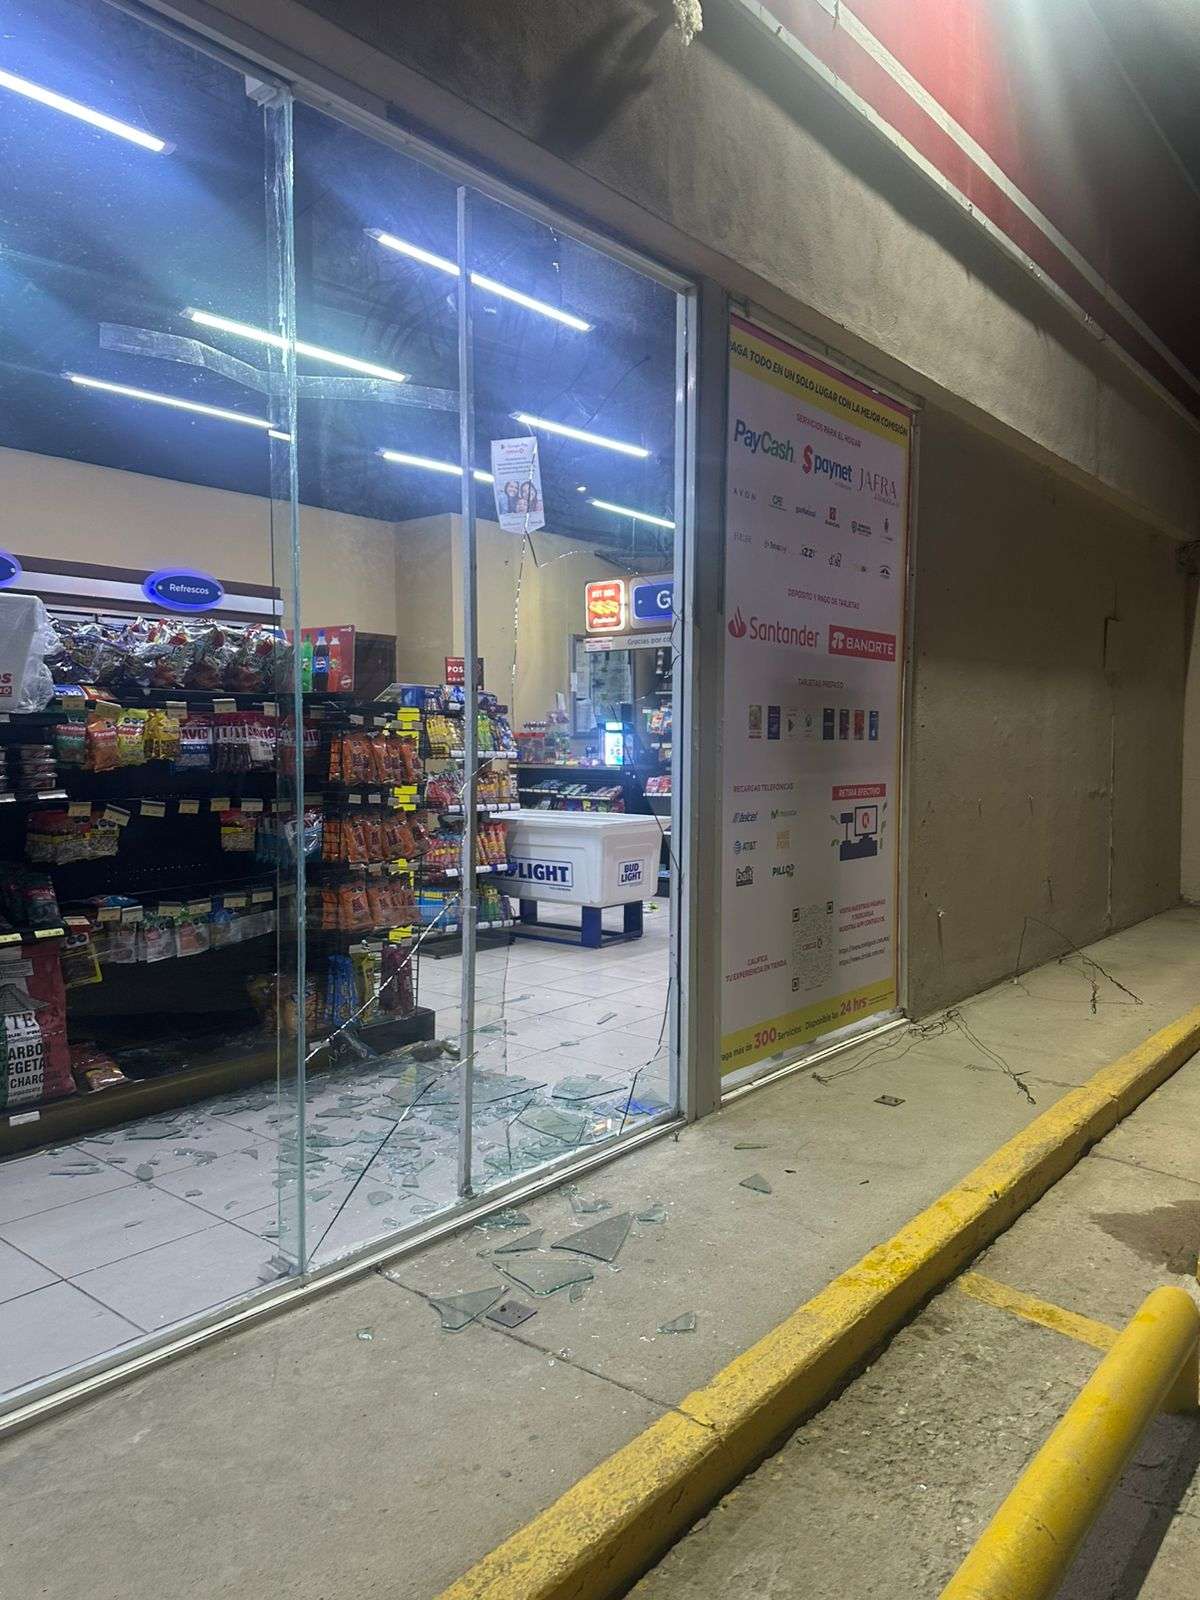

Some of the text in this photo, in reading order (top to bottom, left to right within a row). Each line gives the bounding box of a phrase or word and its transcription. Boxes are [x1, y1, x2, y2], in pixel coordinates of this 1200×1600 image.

[750, 350, 772, 370] TODO
[772, 361, 784, 376] EN
[784, 367, 795, 382] UN
[796, 374, 814, 391] SOLO
[815, 385, 838, 403] LUGAR
[838, 394, 852, 410] CON
[852, 402, 861, 414] LA
[861, 407, 880, 423] MEJOR
[734, 418, 795, 464] PayCash
[857, 468, 897, 499] JAFRA
[168, 583, 210, 596] Refrescos
[656, 589, 672, 610] G
[627, 638, 650, 646] Gracias
[749, 616, 820, 649] Santander
[846, 636, 894, 656] BANORTE
[447, 665, 464, 674] POS
[518, 863, 569, 882] LIGHT
[620, 870, 642, 883] LIGHT
[623, 863, 640, 873] BUD
[721, 1051, 733, 1062] aga
[754, 1027, 777, 1050] 300
[840, 1000, 853, 1017] 24
[853, 997, 868, 1012] hrs
